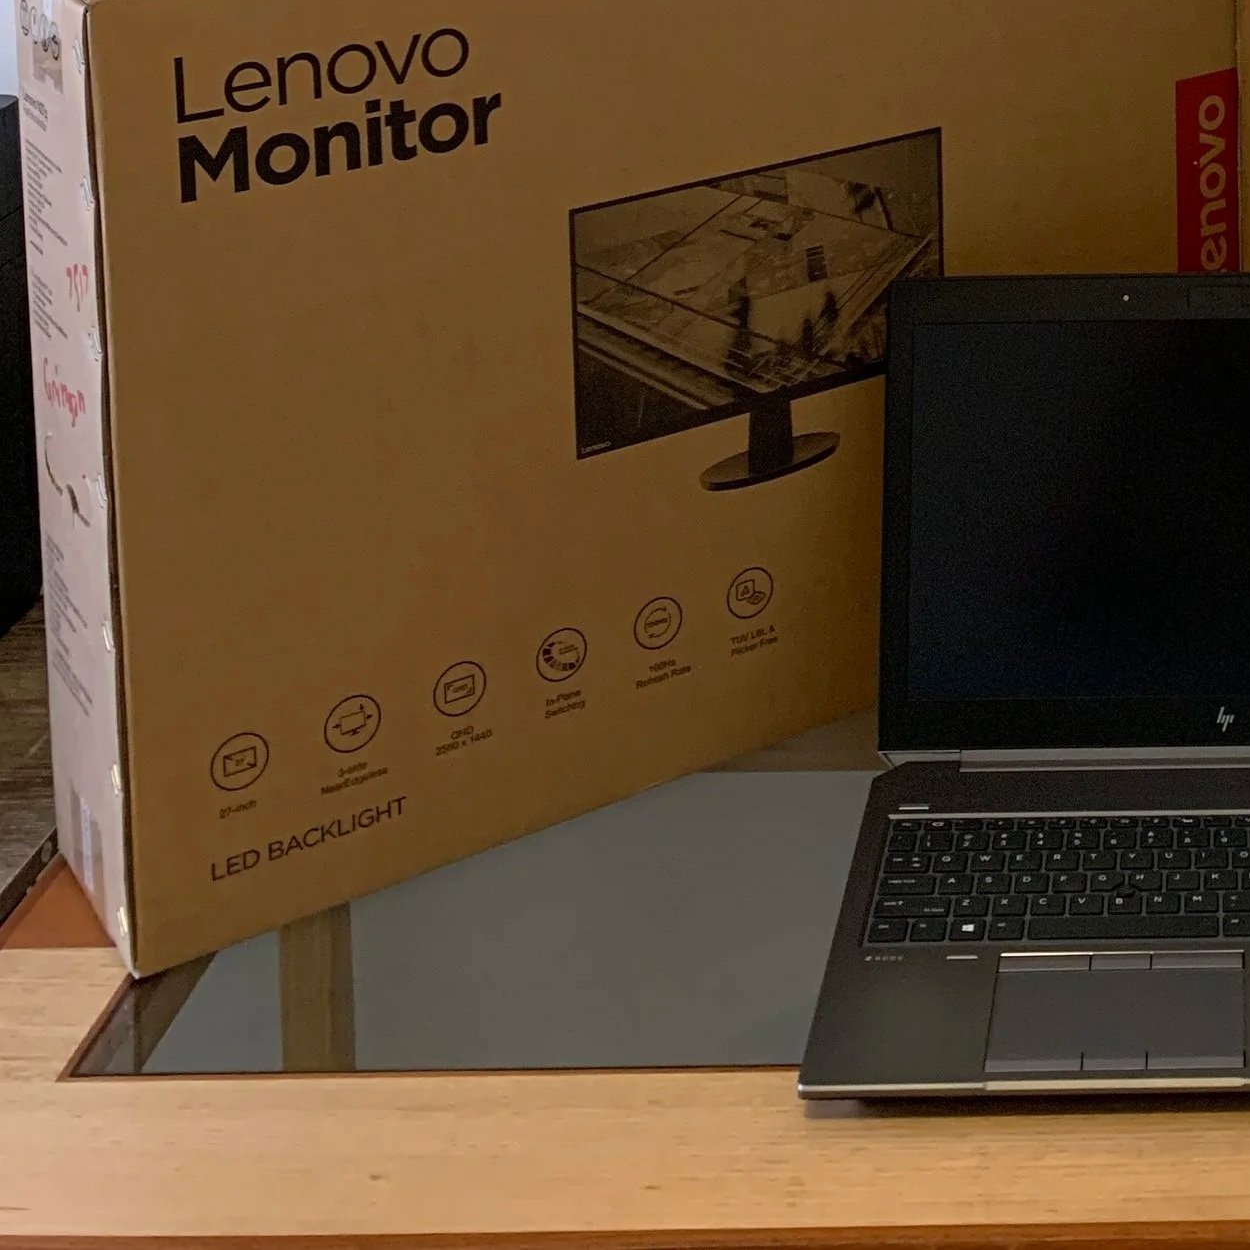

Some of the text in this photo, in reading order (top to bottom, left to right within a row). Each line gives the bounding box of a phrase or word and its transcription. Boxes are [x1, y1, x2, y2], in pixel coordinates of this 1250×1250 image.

[174, 28, 470, 124] Lenovo
[178, 92, 501, 204] Monitor
[1198, 94, 1227, 272] enovo
[1216, 705, 1235, 733] hp
[211, 796, 408, 882] LED BACKLIGHT
